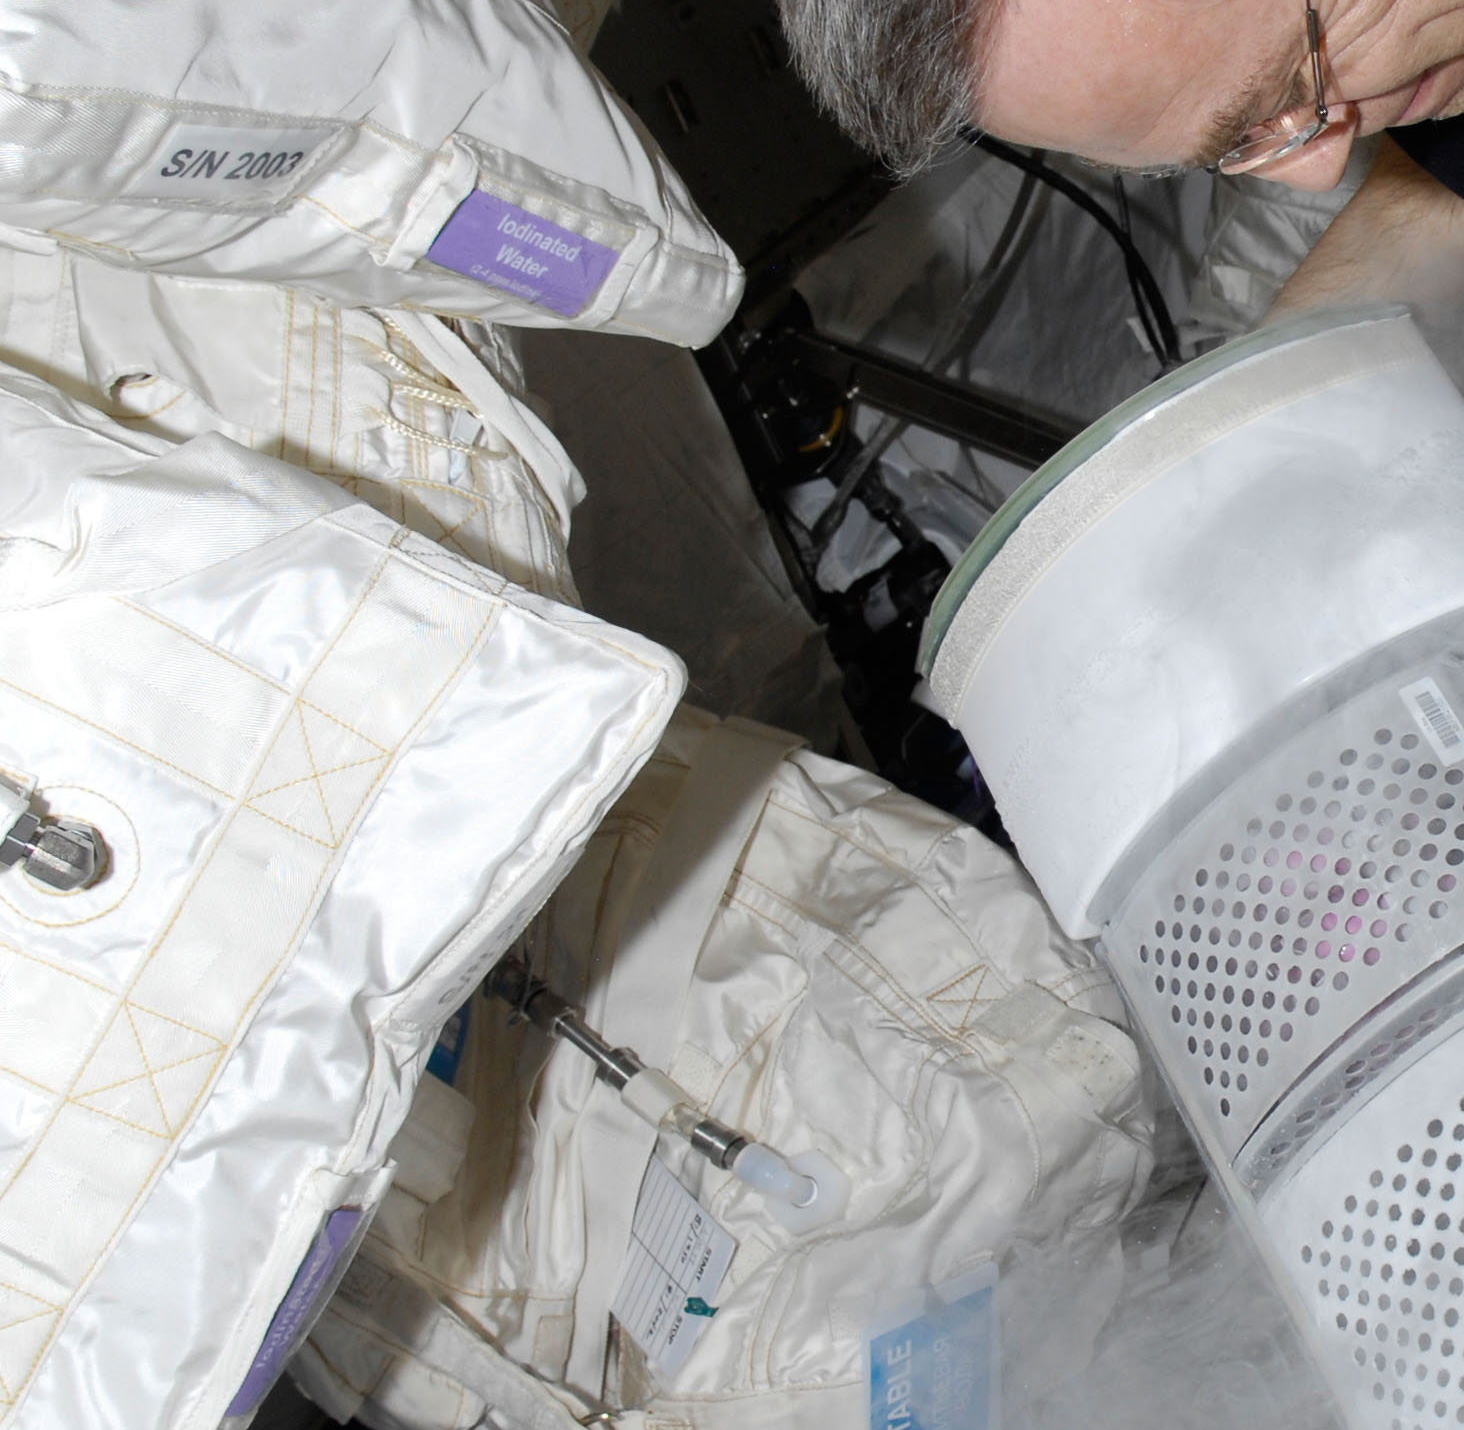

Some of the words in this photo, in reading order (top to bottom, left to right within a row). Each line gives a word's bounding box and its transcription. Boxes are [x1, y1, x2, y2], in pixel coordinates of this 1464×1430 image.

[161, 149, 229, 177] S/N
[224, 151, 303, 179] 2003
[496, 214, 581, 262] Iodinated
[495, 243, 548, 278] Water
[696, 1248, 711, 1282] START
